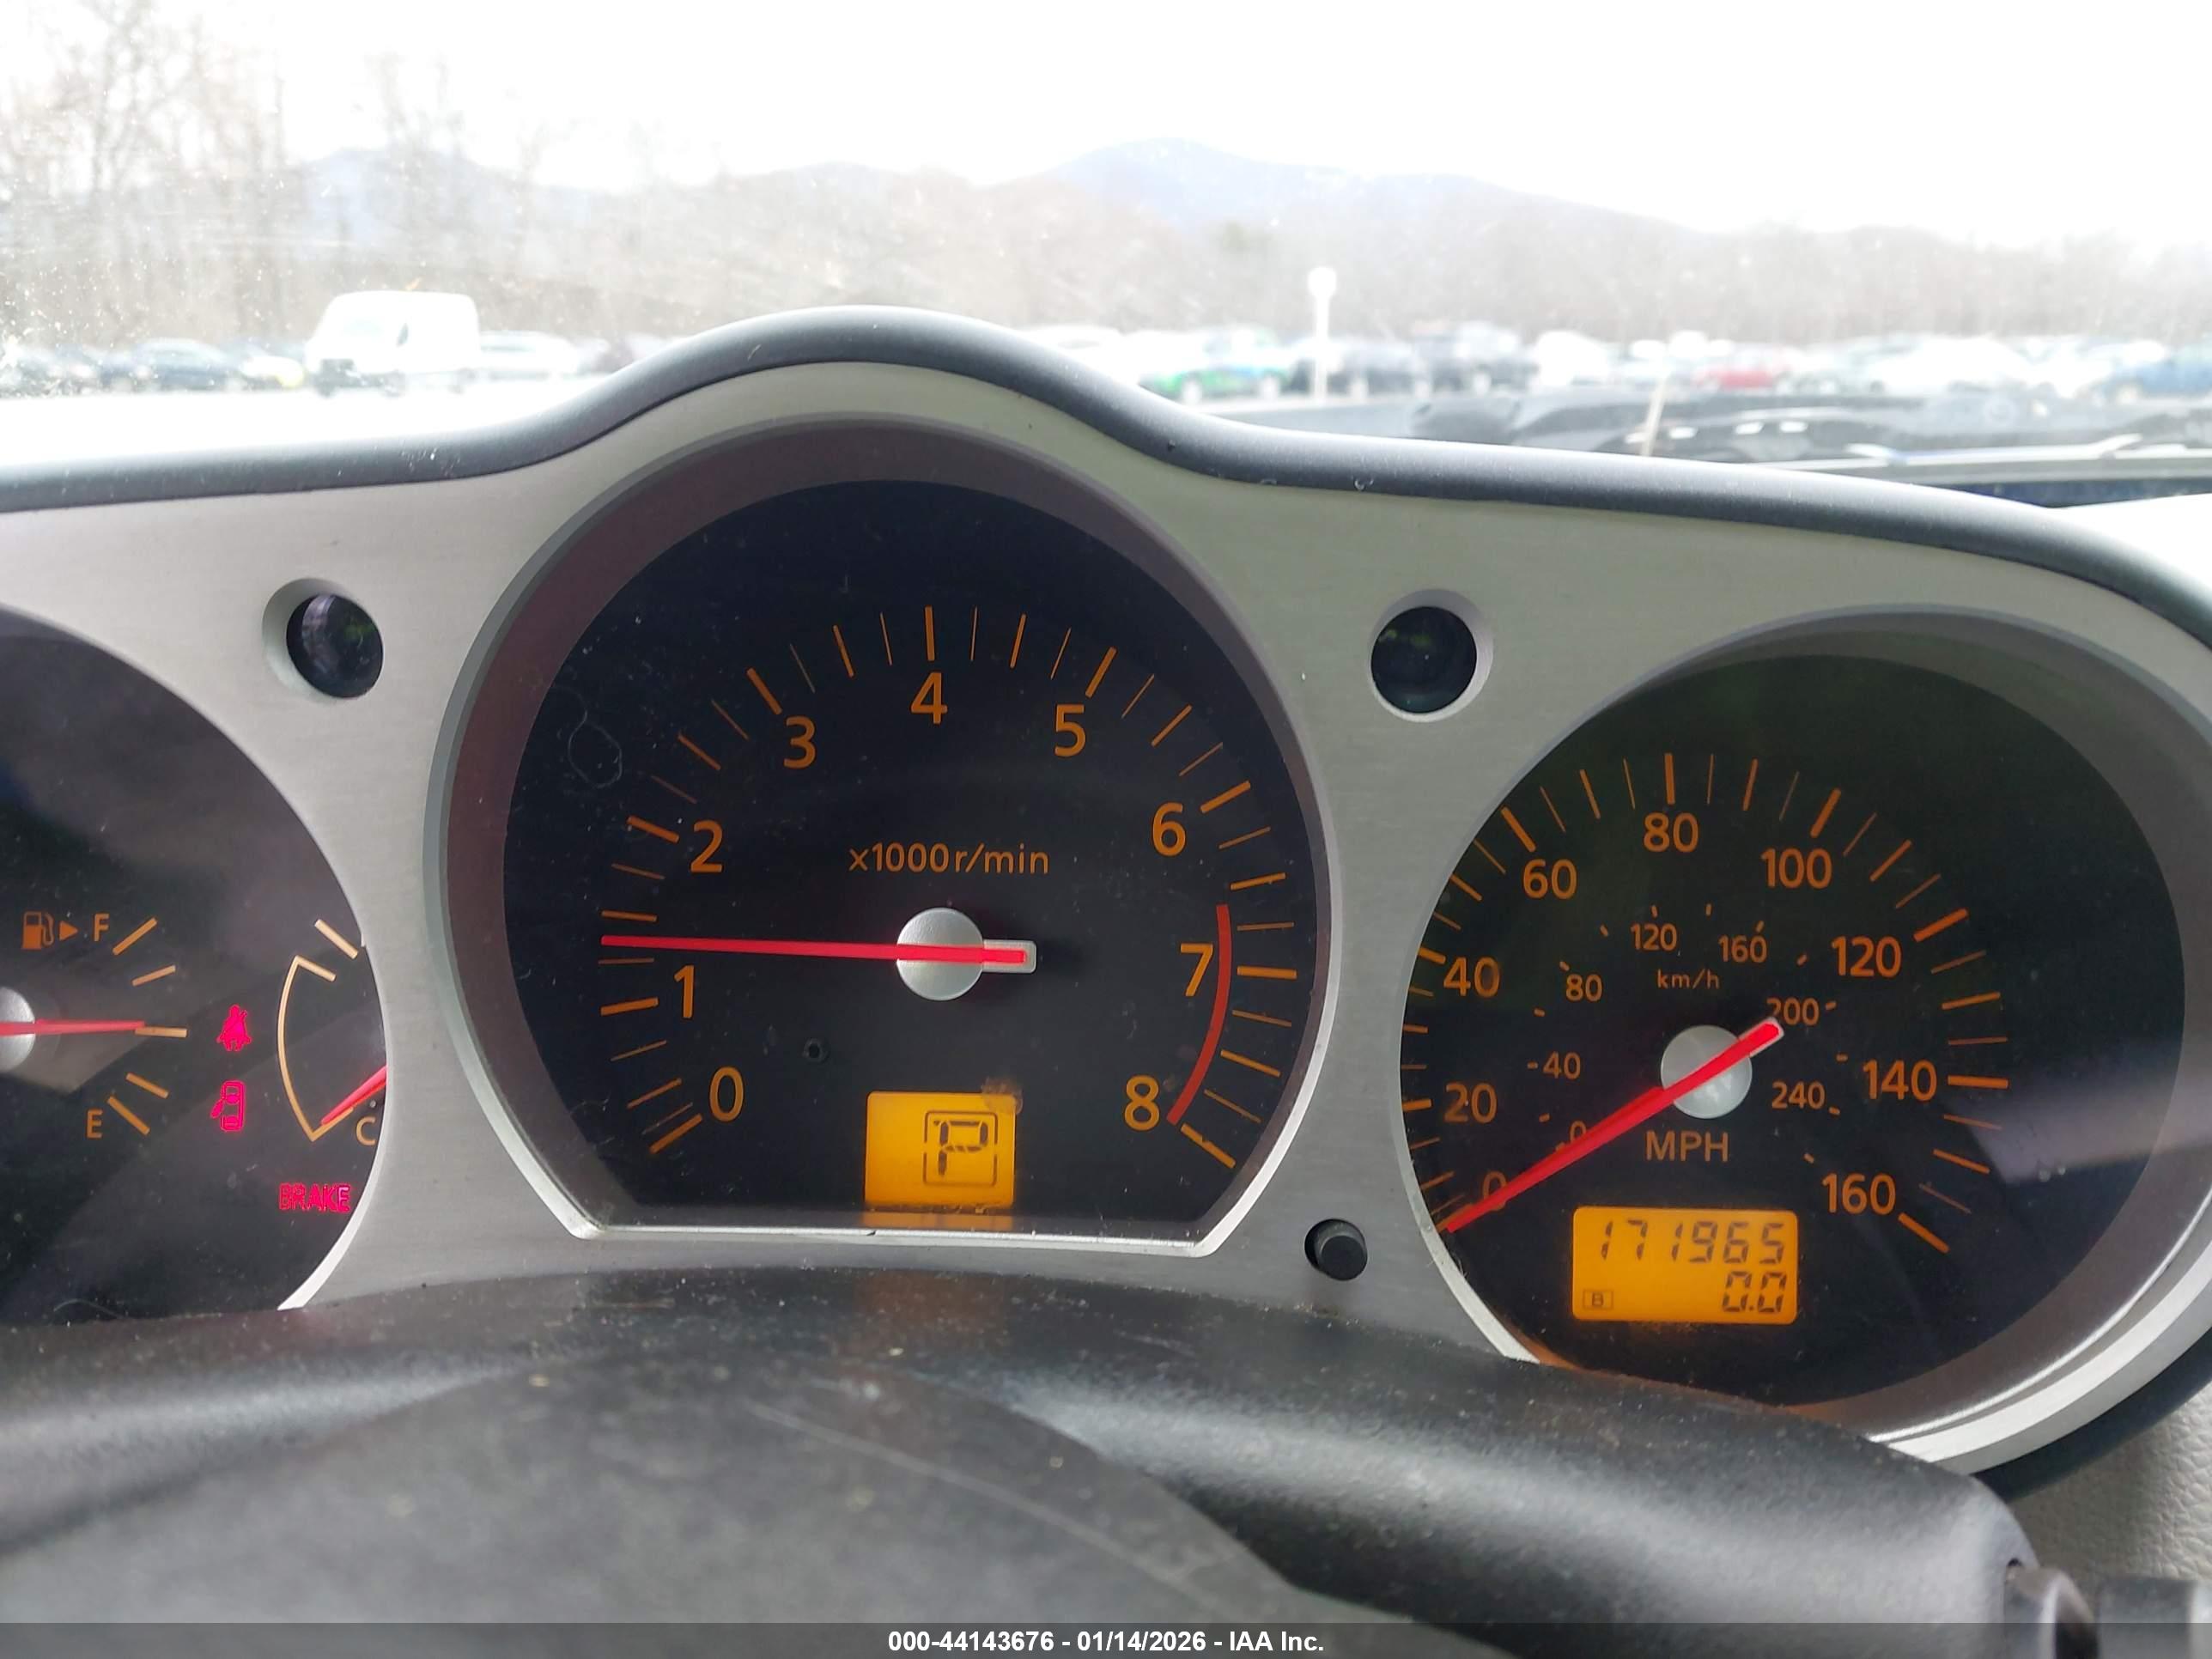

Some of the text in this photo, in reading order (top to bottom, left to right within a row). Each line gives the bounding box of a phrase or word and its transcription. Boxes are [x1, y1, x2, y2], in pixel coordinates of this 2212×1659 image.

[910, 672, 947, 724] 4
[784, 717, 816, 769] 3
[1054, 704, 1085, 756] 5
[690, 821, 722, 872] 2
[1152, 802, 1186, 856] 6
[1644, 811, 1699, 852] 80
[1522, 859, 1577, 899] 60
[1763, 848, 1832, 889] 100
[93, 913, 109, 940] F
[1632, 924, 1677, 951] 120
[1719, 935, 1767, 962] 160
[1832, 936, 1901, 978] 120
[1181, 943, 1214, 997] 7
[1443, 957, 1500, 997] 40
[1565, 975, 1602, 1001] 80
[1656, 969, 1719, 990] km/h
[674, 965, 694, 1018] 1
[1543, 1053, 1580, 1079] 40
[1863, 1060, 1937, 1102] 140
[710, 1066, 744, 1121] 0
[1123, 1075, 1160, 1131] 8
[1444, 1082, 1497, 1123] 20
[1772, 1081, 1825, 1109] 240
[86, 1109, 102, 1139] E
[356, 1116, 376, 1146] C
[934, 1121, 988, 1176] P
[1644, 1130, 1728, 1160] MPH
[280, 1183, 350, 1212] BRAKE
[1822, 1173, 1896, 1215] 160
[1601, 1218, 1784, 1265] 171965
[1722, 1270, 1787, 1313] 0.0
